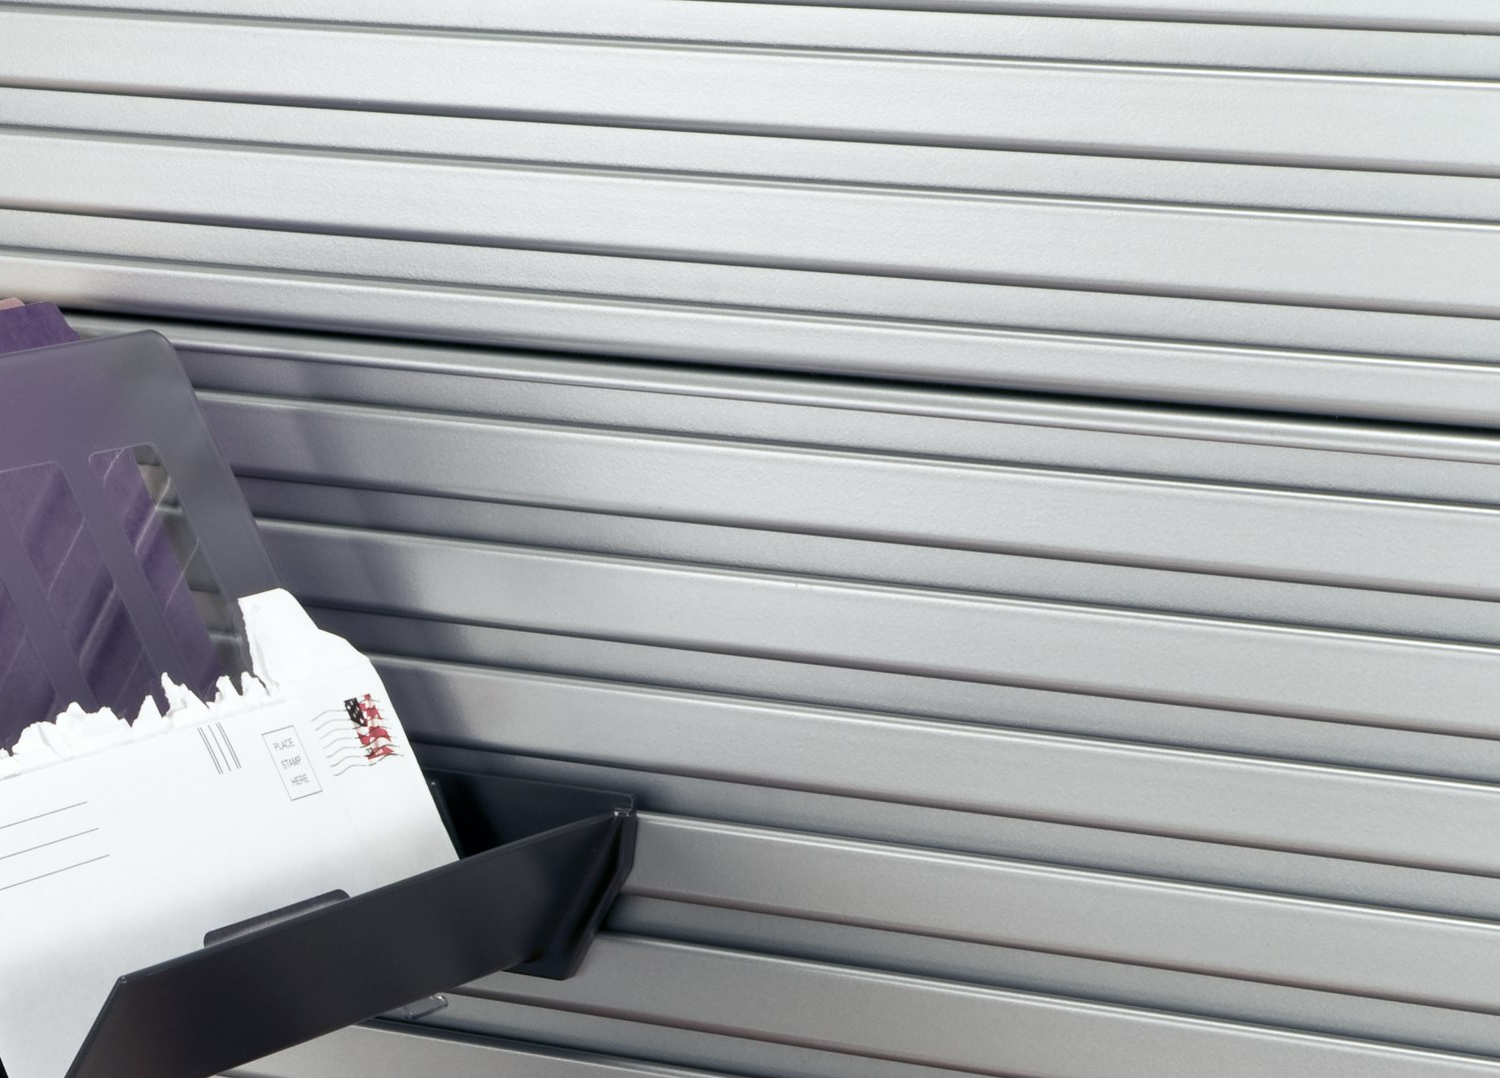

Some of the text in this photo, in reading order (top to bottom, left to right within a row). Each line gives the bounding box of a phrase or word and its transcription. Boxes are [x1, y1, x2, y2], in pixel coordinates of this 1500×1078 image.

[273, 738, 296, 751] PLACE
[281, 756, 302, 769] STAMP
[291, 774, 310, 786] HERE
